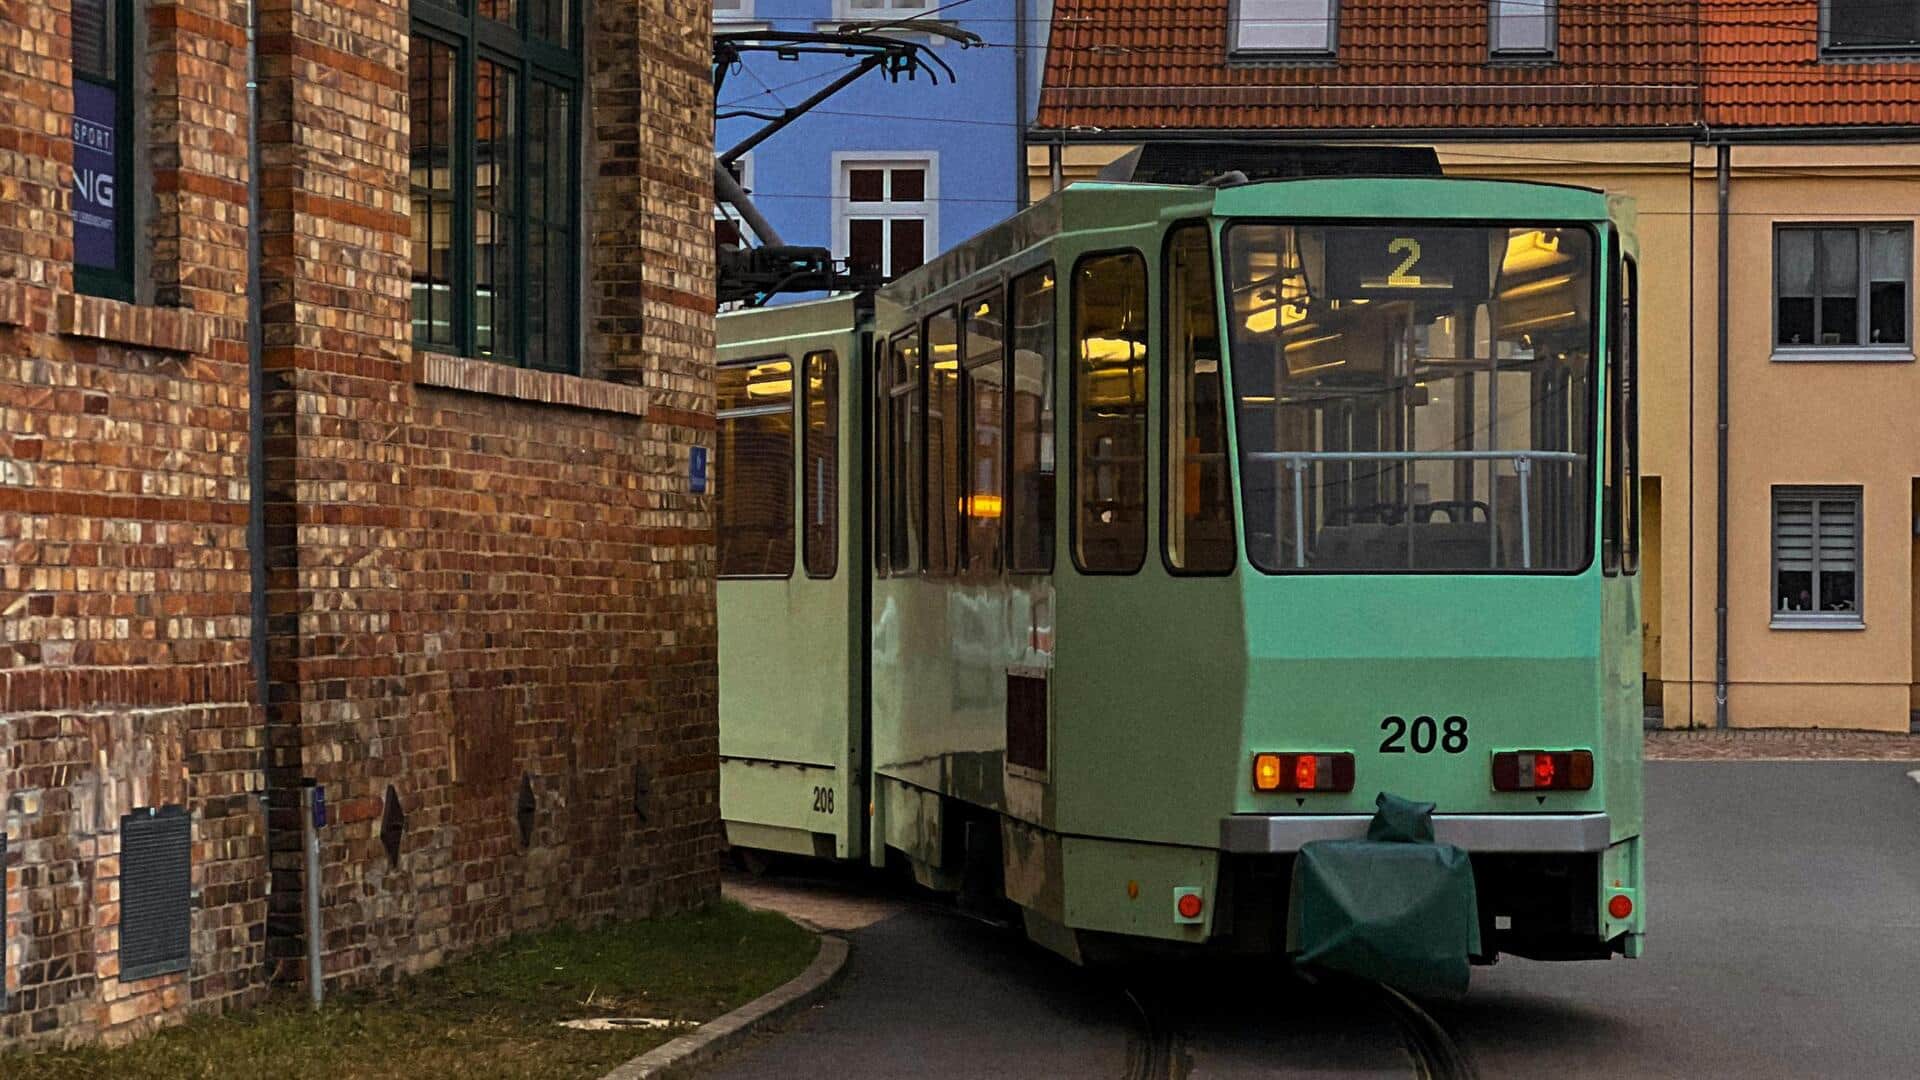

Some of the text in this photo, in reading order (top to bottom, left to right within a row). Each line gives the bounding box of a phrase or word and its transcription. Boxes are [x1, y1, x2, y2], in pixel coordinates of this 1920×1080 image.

[1388, 238, 1421, 286] 2
[1379, 715, 1469, 754] 208
[813, 785, 835, 814] 208
